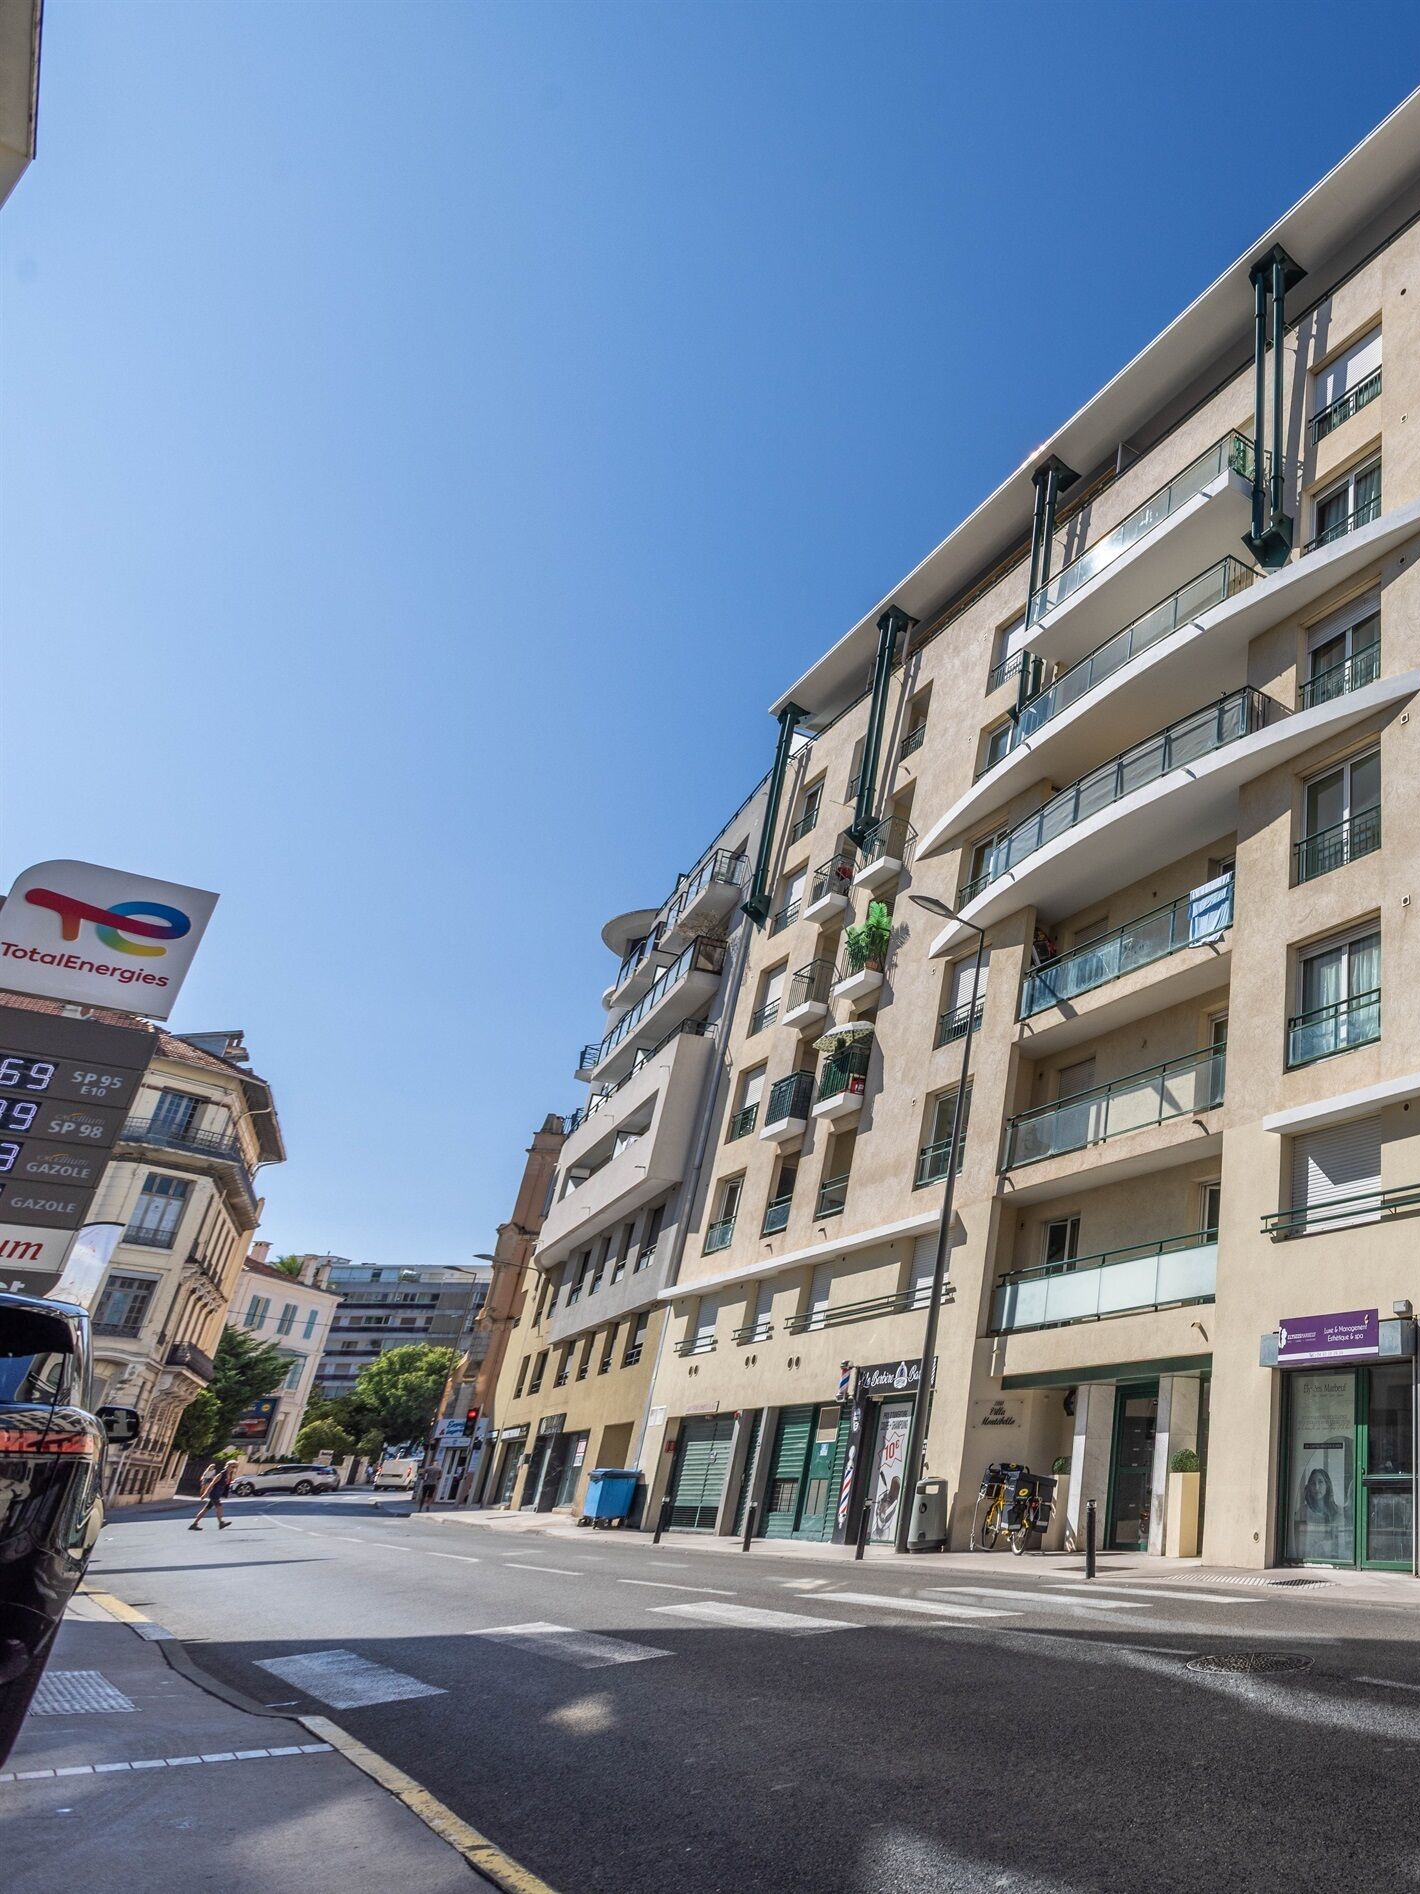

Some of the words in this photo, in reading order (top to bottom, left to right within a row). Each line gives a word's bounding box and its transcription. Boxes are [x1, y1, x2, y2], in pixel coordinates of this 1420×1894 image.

[1, 942, 170, 987] TotalEnergies
[72, 1072, 98, 1084] SP
[100, 1076, 122, 1088] 95
[80, 1086, 106, 1096] E10
[48, 1121, 75, 1134] SP
[78, 1124, 104, 1138] 98
[26, 1162, 91, 1178] GAZOLE
[11, 1197, 76, 1213] GAZOLE
